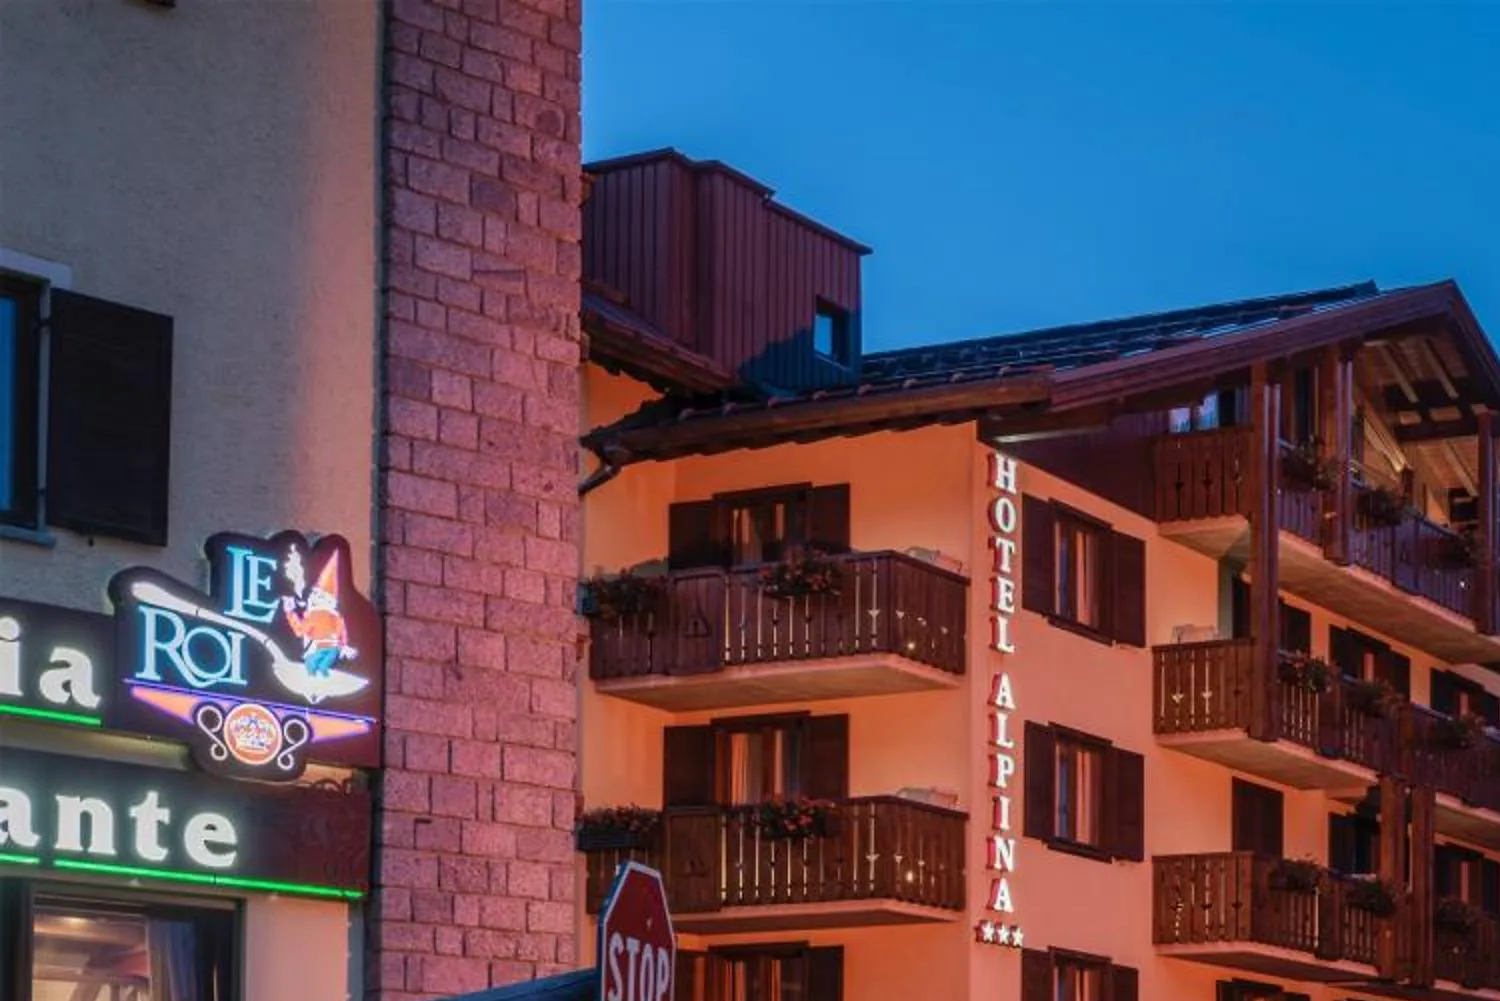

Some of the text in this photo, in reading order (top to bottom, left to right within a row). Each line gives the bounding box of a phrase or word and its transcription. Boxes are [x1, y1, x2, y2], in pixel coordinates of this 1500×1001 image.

[224, 544, 280, 622] LE
[993, 452, 1018, 654] HOTEL
[134, 604, 248, 688] ROI
[993, 671, 1016, 913] ALPINA
